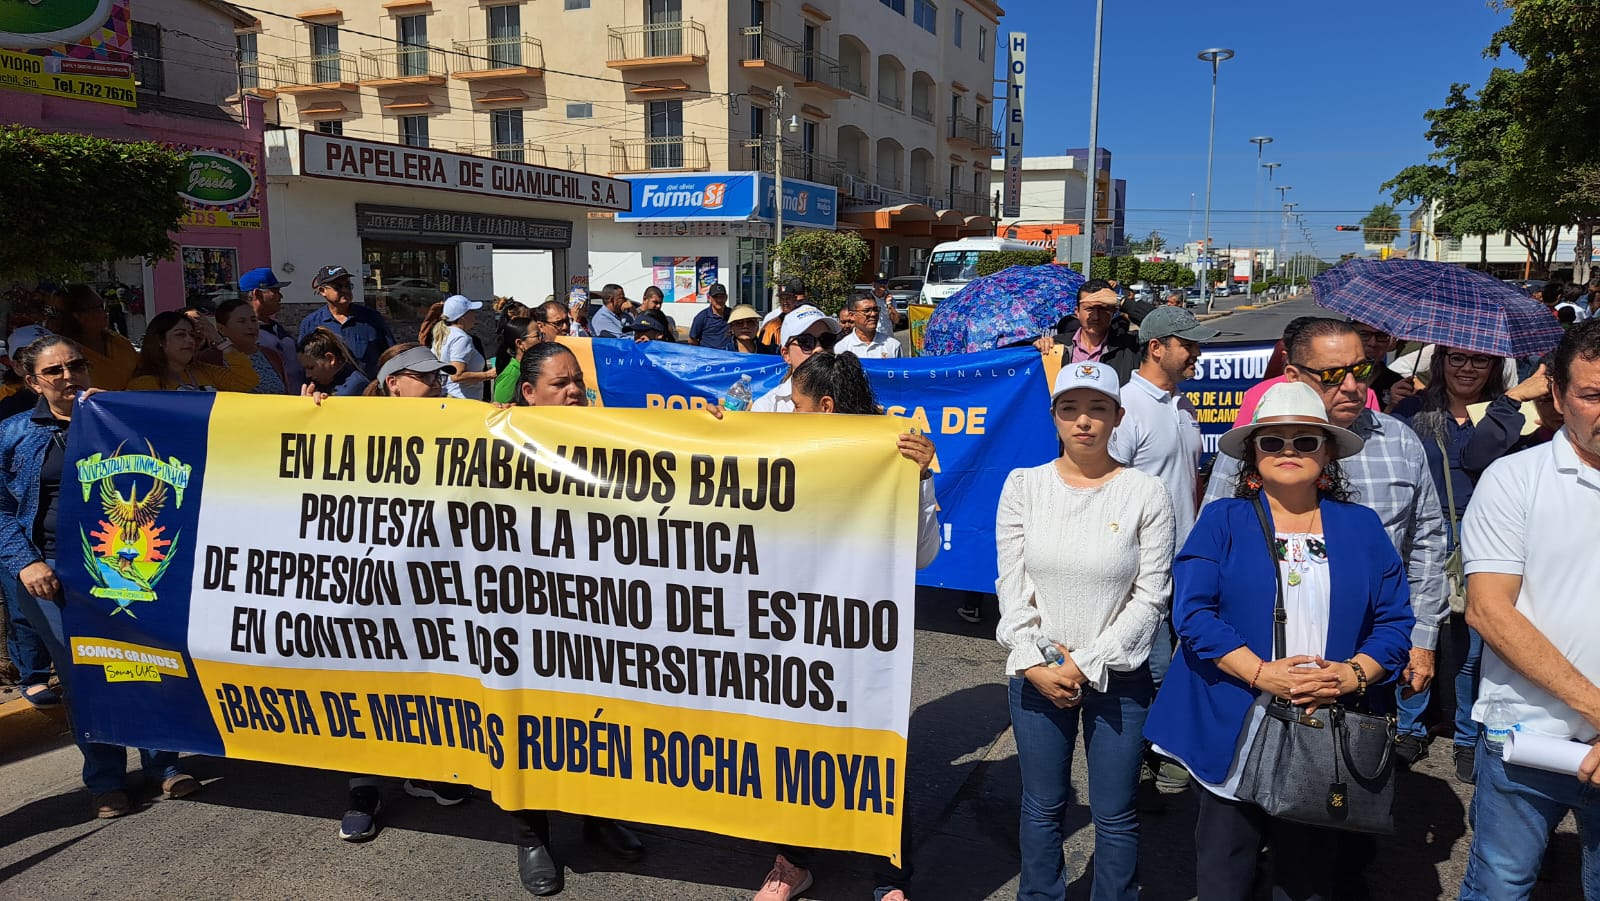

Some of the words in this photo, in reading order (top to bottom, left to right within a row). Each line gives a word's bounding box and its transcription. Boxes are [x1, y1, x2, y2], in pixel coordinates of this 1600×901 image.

[53, 77, 77, 94] Tel.
[80, 82, 102, 98] 732
[104, 86, 134, 101] 7676
[1011, 37, 1025, 147] HOTEL
[326, 142, 447, 184] PAPELERA
[459, 160, 484, 188] DE
[367, 214, 416, 230] JOYERIA
[422, 212, 474, 233] GARCIA
[477, 218, 526, 237] CUADRA
[606, 357, 740, 374] UNIVERSIDAD
[888, 369, 910, 379] DE
[930, 367, 1031, 379] SINALOA
[1202, 391, 1217, 406] DE
[1218, 391, 1232, 406] LA
[940, 406, 988, 435] DE
[279, 432, 317, 479] EN
[322, 433, 356, 482] LA
[366, 435, 424, 486] UAS
[435, 436, 677, 505] TRABAJAMOS
[689, 453, 796, 512] BAJO
[299, 493, 440, 548] PROTESTA
[447, 500, 521, 553] POR
[531, 506, 575, 560] LA
[587, 506, 760, 576] POLÍTICA
[203, 545, 239, 592] DE
[245, 546, 402, 607] REPRESIÓN
[407, 560, 472, 607] DEL
[474, 563, 653, 631] GOBIERNO
[666, 583, 736, 637] DEL
[748, 589, 899, 652] ESTADO
[77, 644, 124, 660] SOMOS
[124, 649, 180, 670] GRANDES
[135, 664, 158, 678] UAS
[230, 606, 267, 655] EN
[275, 610, 408, 660] CONTRA
[412, 617, 459, 662] DE
[532, 629, 848, 713] UNIVERSITARIOS.
[216, 682, 321, 736] ¡BASTA
[321, 690, 366, 740] DE
[518, 707, 633, 780] RUBÉN
[643, 728, 763, 800] ROCHA
[775, 746, 896, 816] MOYA!
